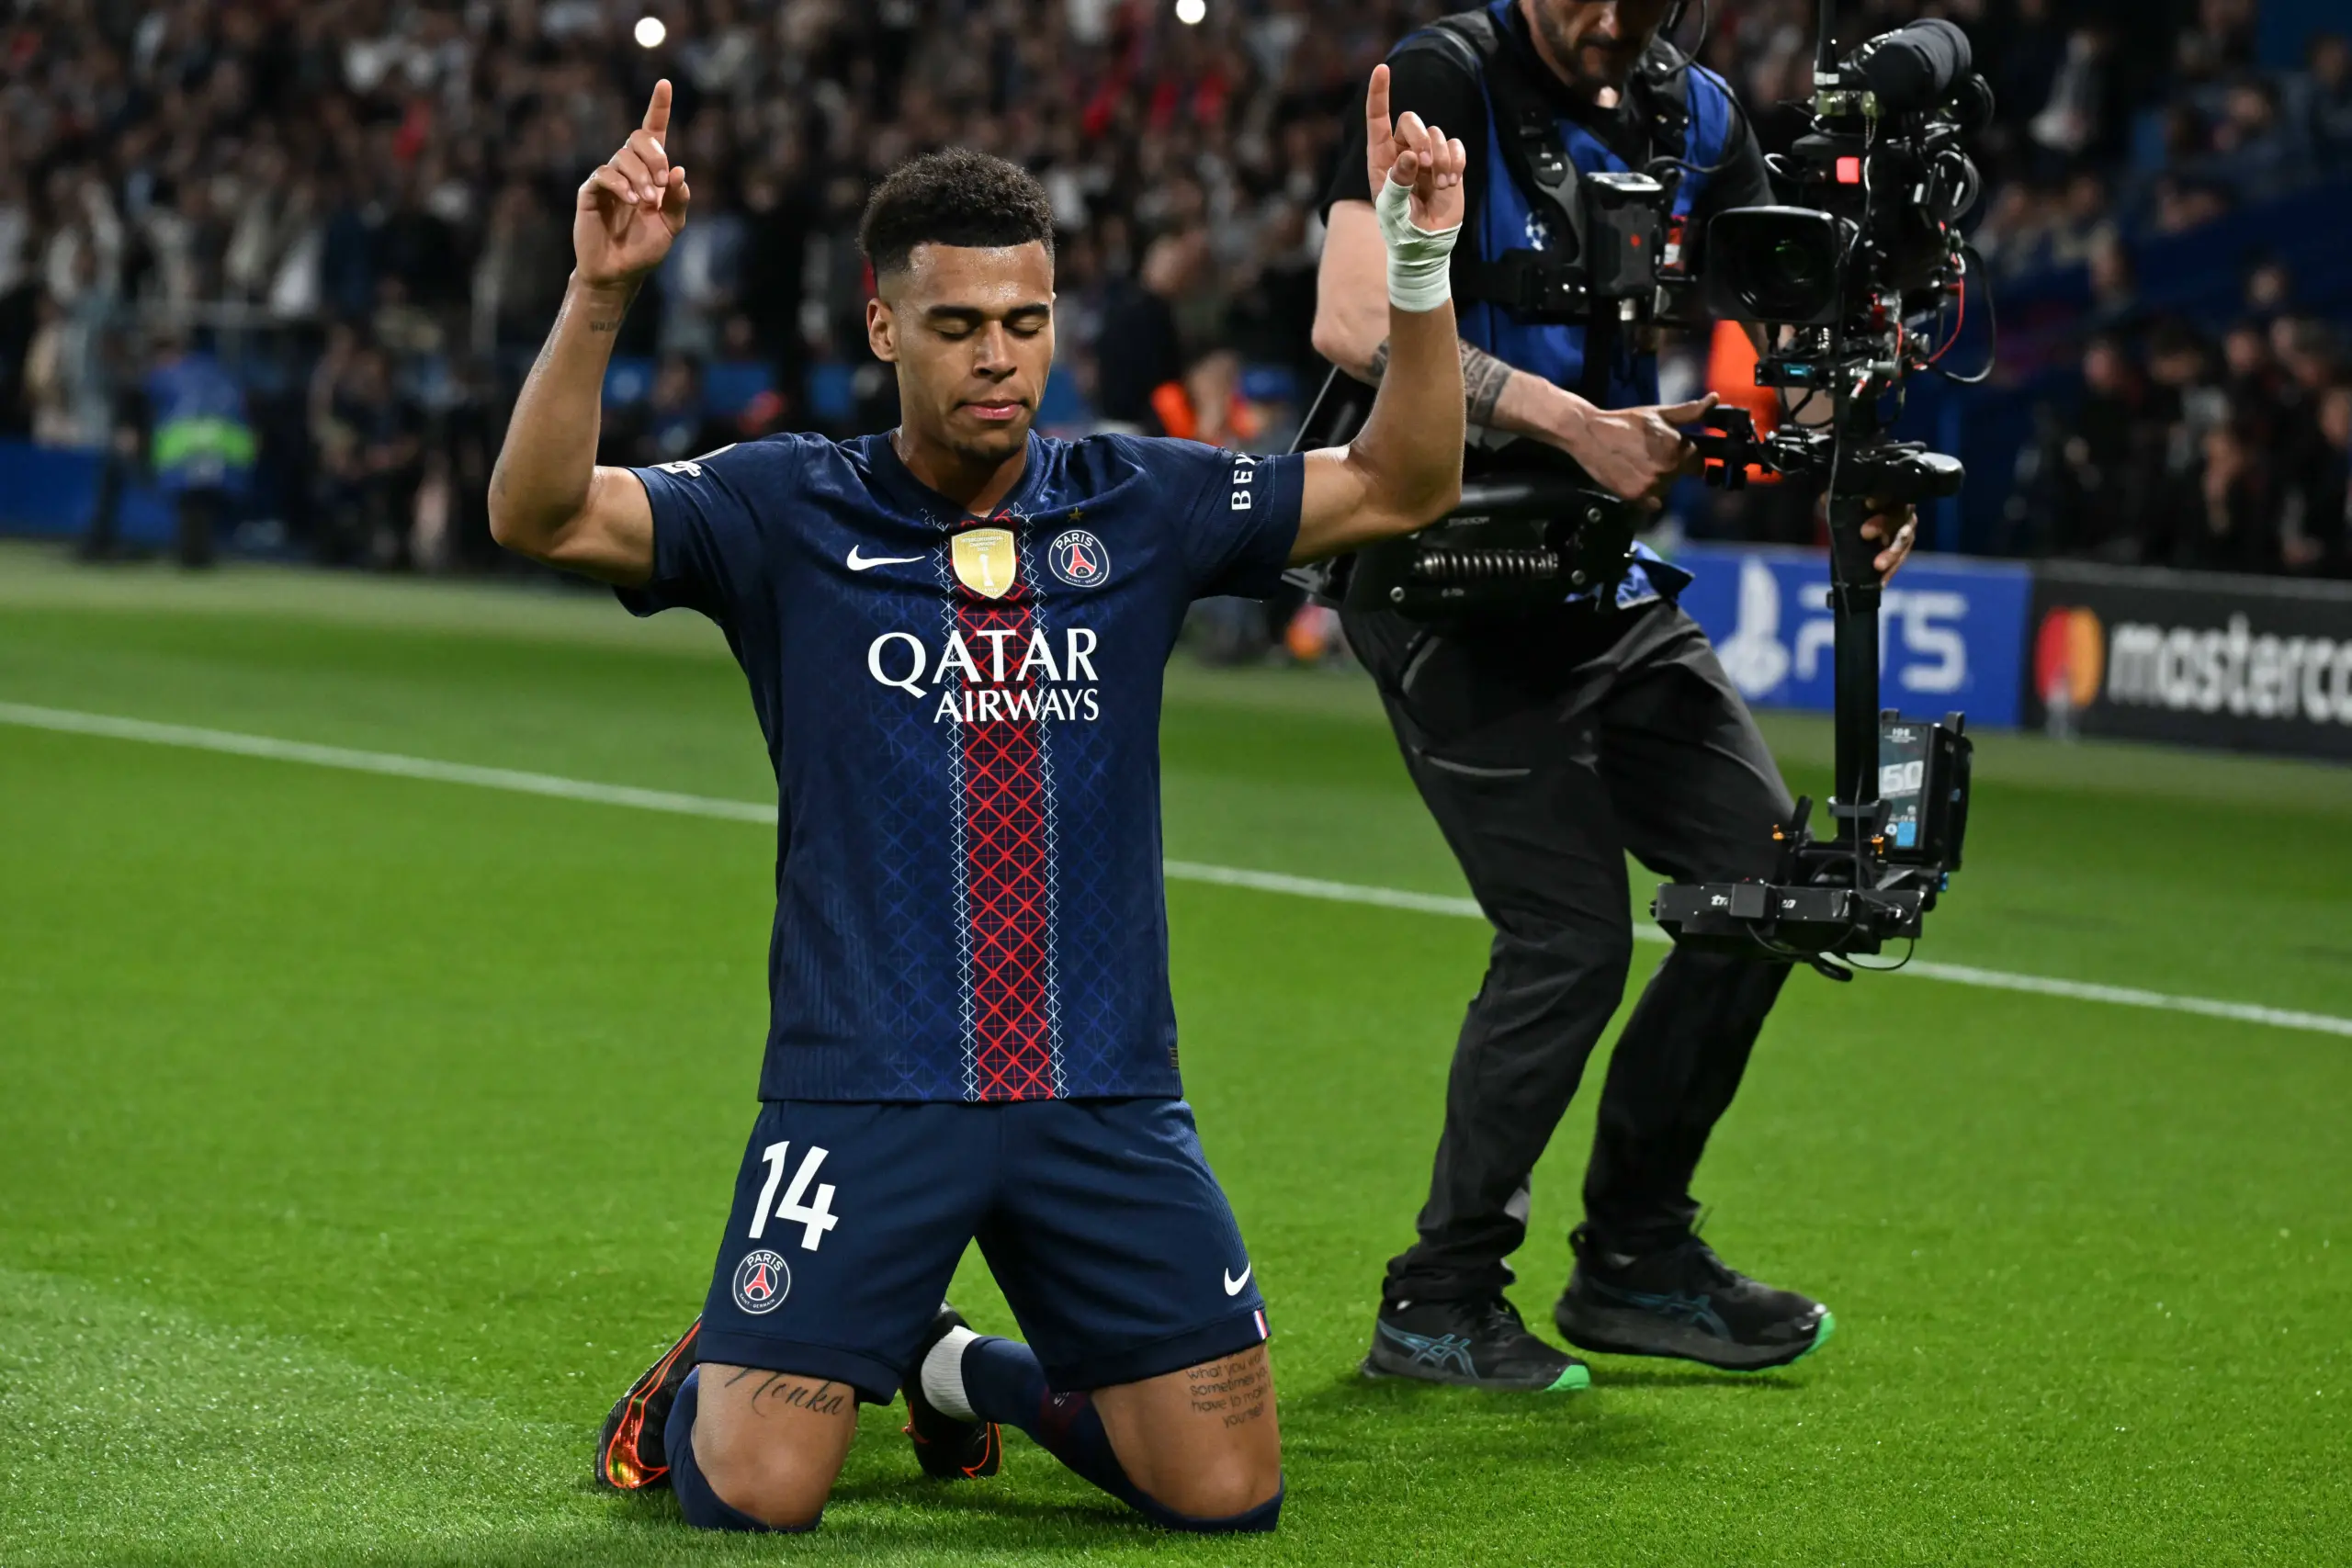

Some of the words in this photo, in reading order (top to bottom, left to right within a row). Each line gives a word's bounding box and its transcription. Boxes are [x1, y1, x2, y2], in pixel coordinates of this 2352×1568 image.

[1055, 533, 1093, 550] PARIS
[867, 628, 1099, 699] QATAR
[933, 689, 1099, 723] AIRWAYS
[749, 1141, 839, 1251] 14
[746, 1253, 784, 1271] PARIS
